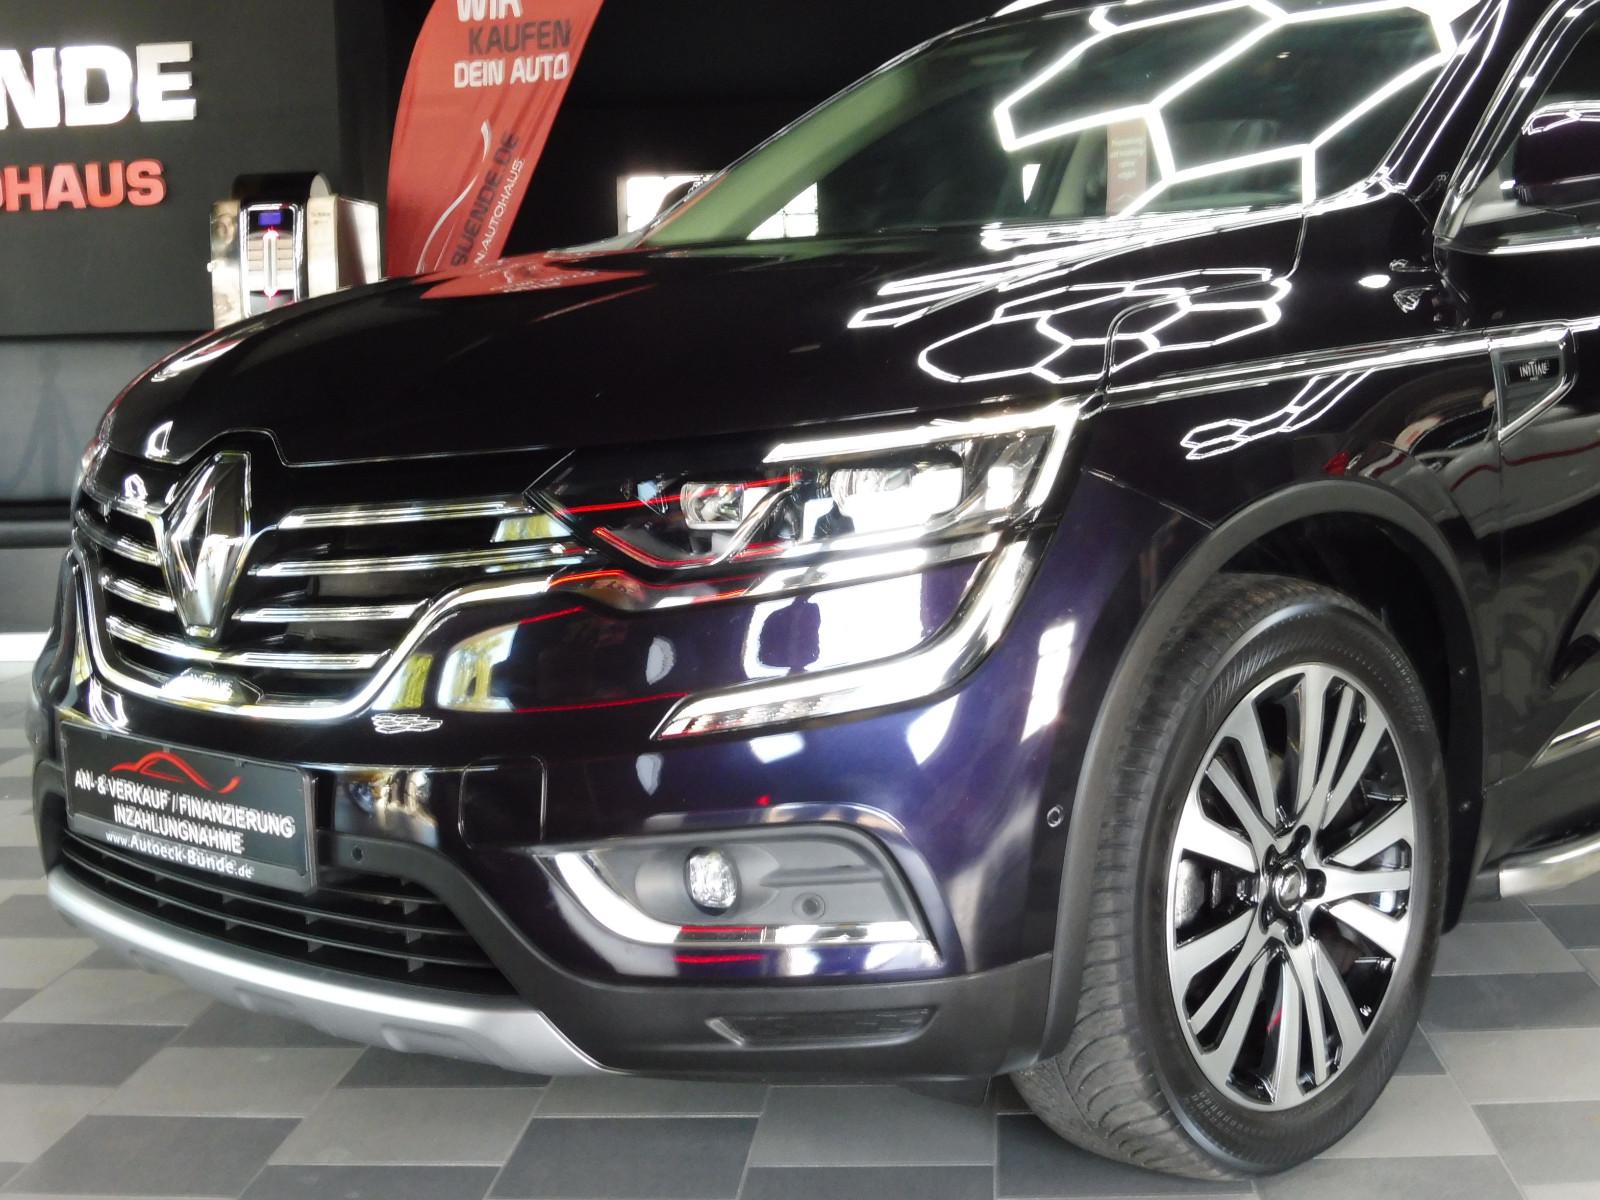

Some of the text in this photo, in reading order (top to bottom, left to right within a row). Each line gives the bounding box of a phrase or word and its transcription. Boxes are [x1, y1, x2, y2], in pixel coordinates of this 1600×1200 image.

[468, 19, 572, 55] KAUFEN
[453, 52, 570, 88] DEIN AUTO
[0, 159, 166, 212] HAUS
[97, 775, 107, 795] &
[108, 777, 170, 810] VERKAUF
[179, 794, 295, 838] FINANZIERUNG
[114, 803, 244, 854] INZAHLUNGNAHME
[105, 831, 254, 878] www.Autoeck-Bünde.de
